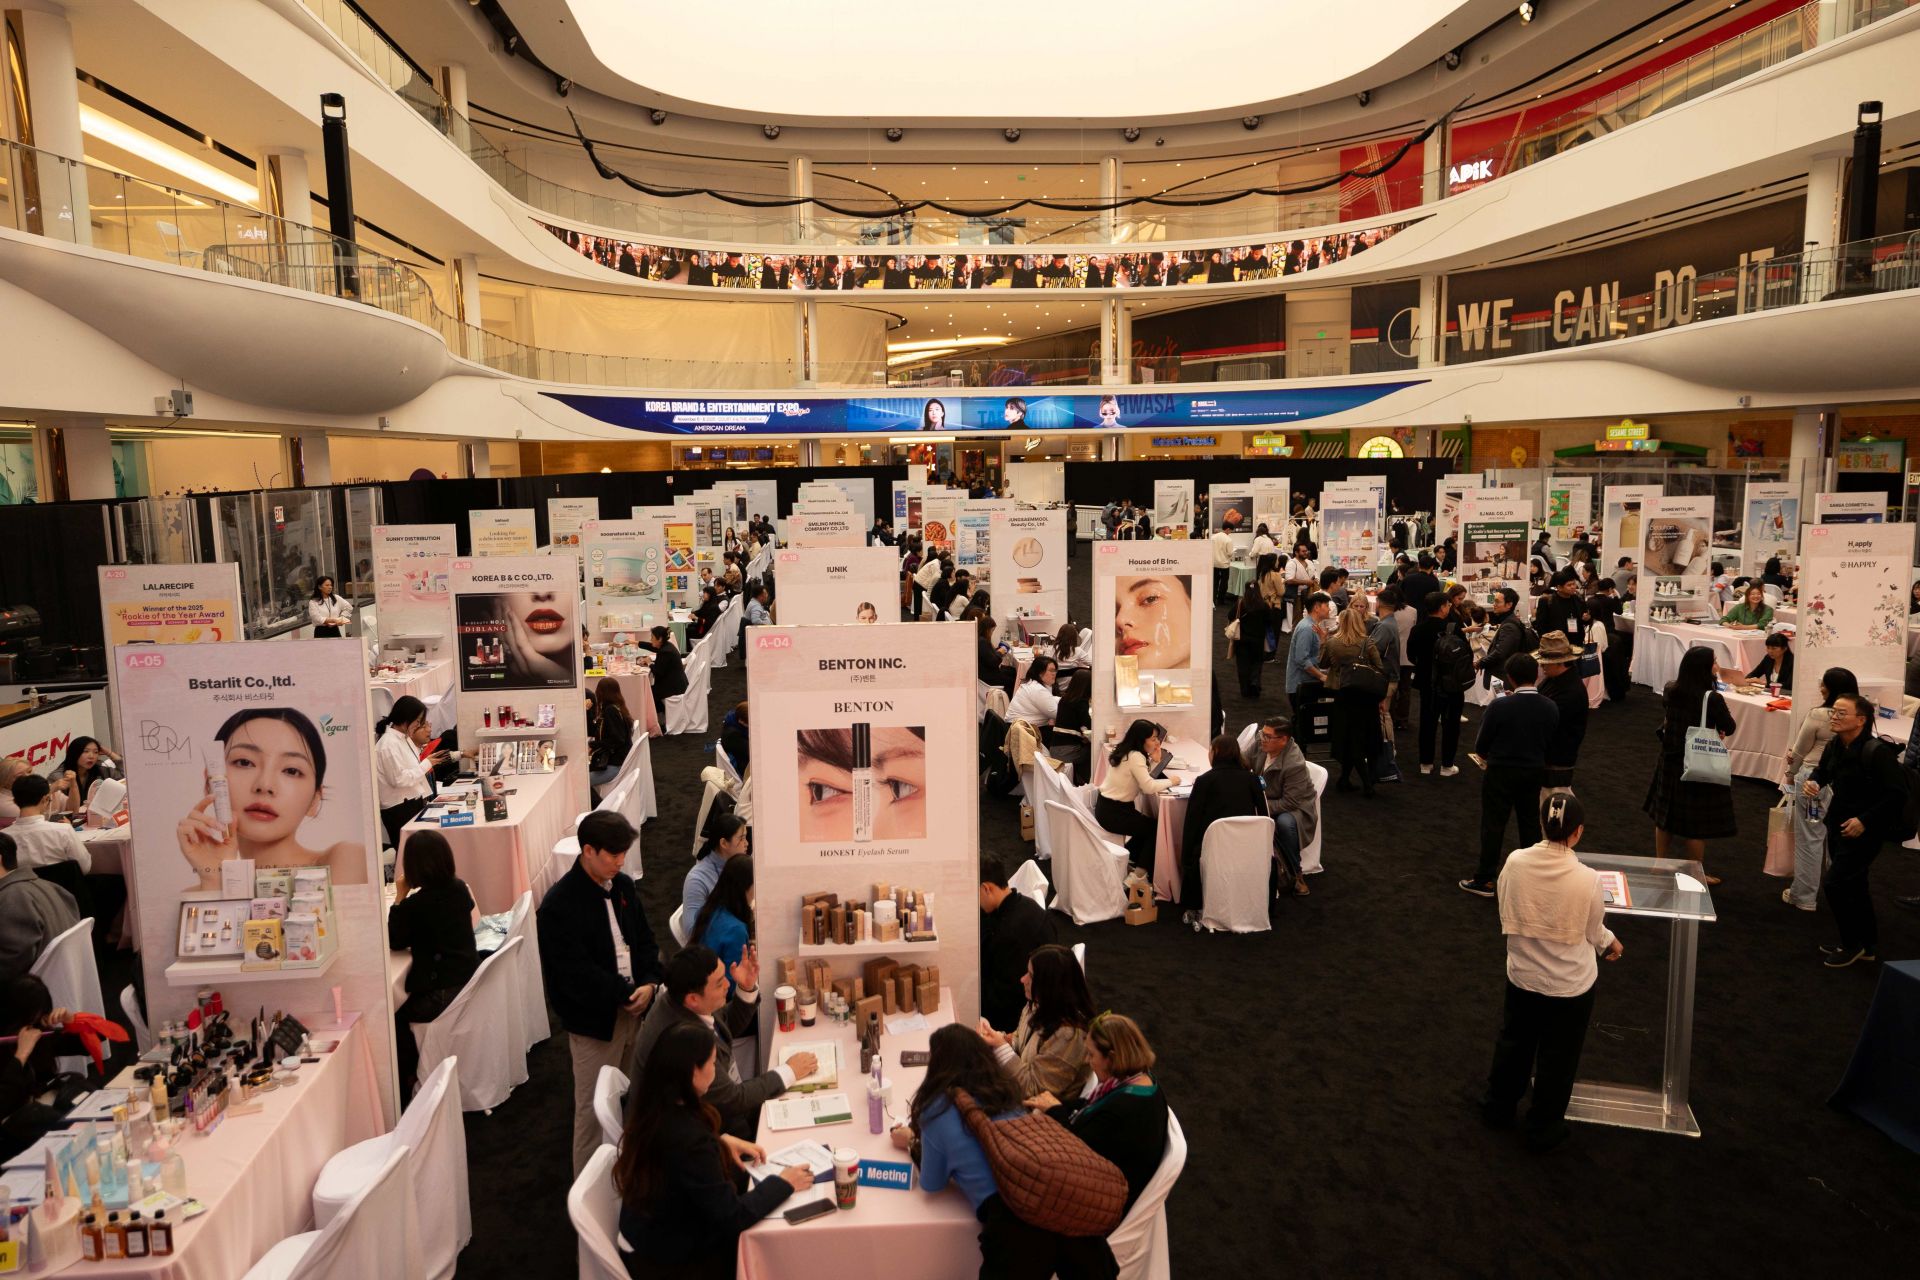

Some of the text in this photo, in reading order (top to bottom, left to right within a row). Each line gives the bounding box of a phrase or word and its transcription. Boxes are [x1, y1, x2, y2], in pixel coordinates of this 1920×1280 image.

[1458, 247, 1775, 351] WE CAN DO IT
[645, 401, 799, 413] KOREA BRAND & ENTERTAINMENT EXPO
[1118, 395, 1176, 415] HWASA
[1128, 558, 1151, 566] House
[1152, 558, 1160, 566] of
[472, 574, 499, 582] KOREA
[522, 573, 554, 582] CO.,LTD.
[143, 583, 195, 591] LALARECIPE
[123, 613, 150, 621] Rookie
[152, 612, 160, 620] of
[179, 611, 197, 619] Year
[200, 610, 226, 618] Award
[760, 638, 789, 648] A-04
[129, 655, 162, 667] A-05
[819, 657, 906, 671] BENTON INC.
[189, 675, 296, 690] Bstarlit Co.,ltd.
[212, 693, 243, 703] 주식회사
[833, 700, 894, 714] BENTON
[5, 732, 71, 768] CM
[820, 846, 909, 858] HONEST Eyelash Serum
[867, 1167, 908, 1183] Meeting
